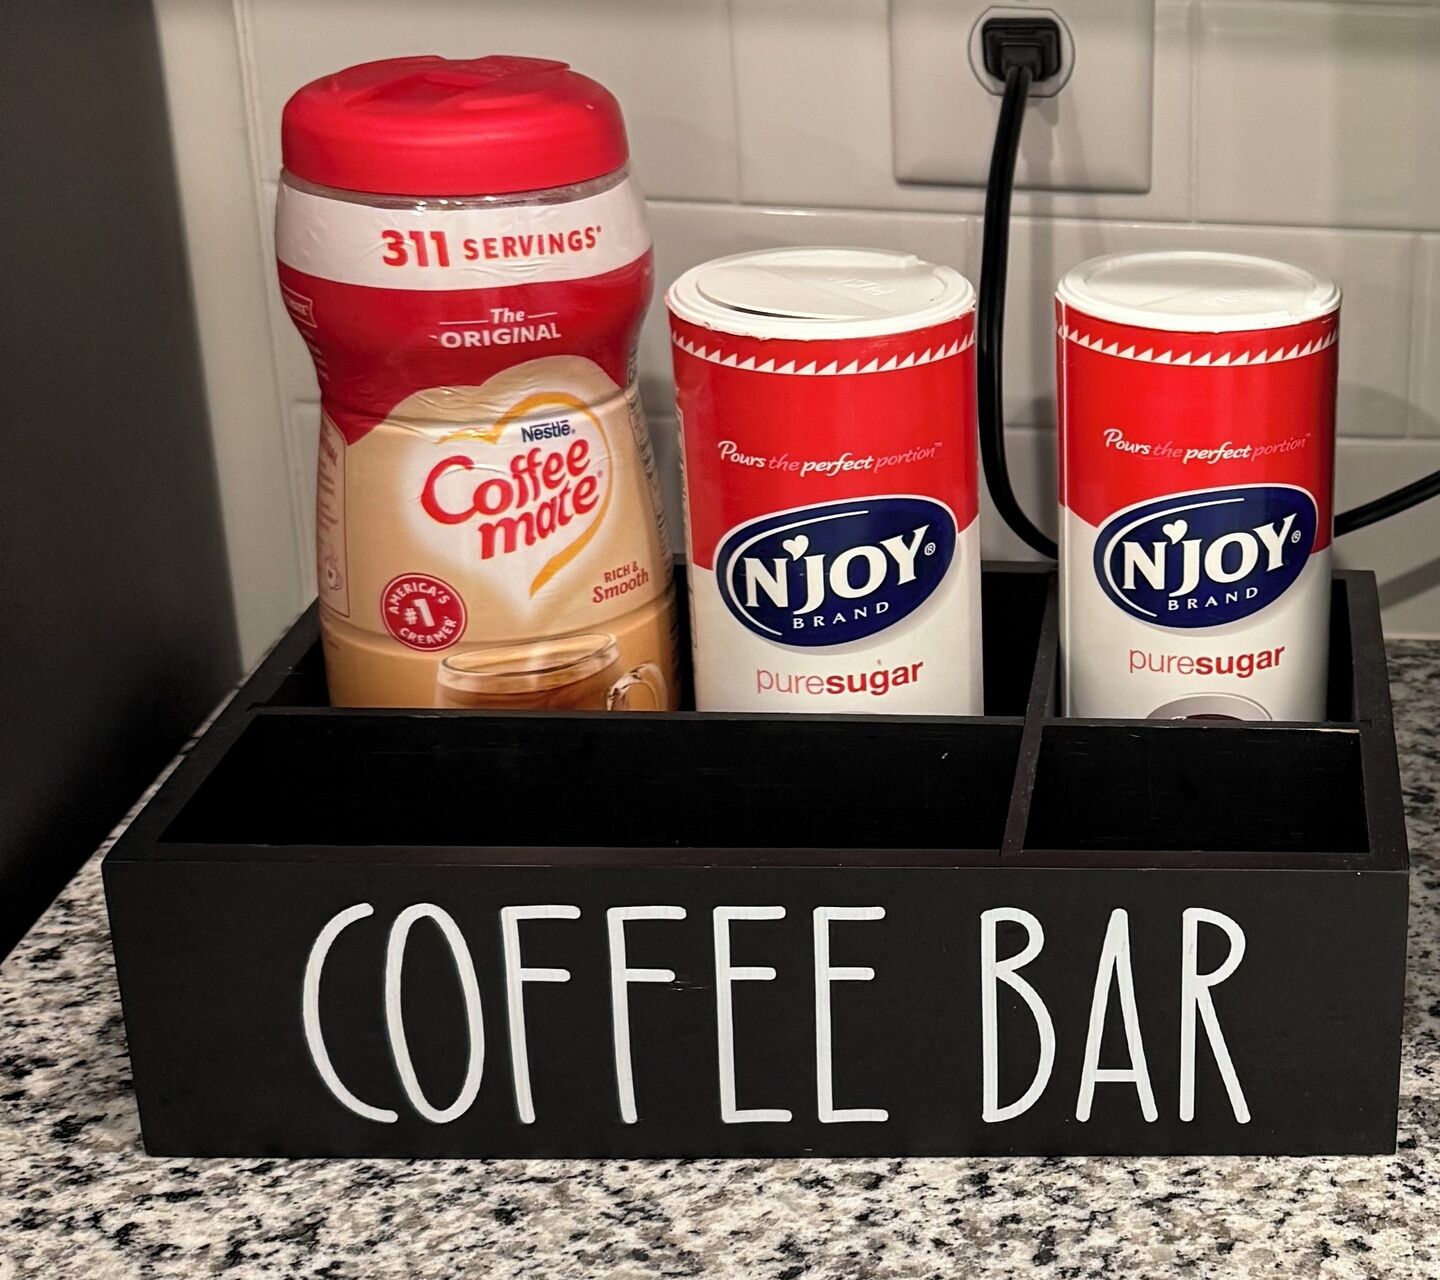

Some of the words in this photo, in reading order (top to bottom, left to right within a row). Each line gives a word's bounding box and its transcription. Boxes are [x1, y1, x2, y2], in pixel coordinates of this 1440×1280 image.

[382, 229, 451, 267] 311
[490, 308, 525, 324] The
[440, 322, 562, 349] ORIGINAL
[718, 440, 766, 468] Pours
[768, 453, 800, 471] the
[800, 452, 875, 477] perfect
[1103, 428, 1151, 455] Pours
[1152, 441, 1184, 459] the
[1183, 441, 1252, 464] perfect
[421, 439, 590, 525] Coffee
[478, 475, 600, 560] mate
[592, 568, 649, 603] Smooth
[604, 564, 631, 583] RICH
[632, 560, 639, 572] &
[389, 582, 451, 615] AMERICA'S
[404, 598, 436, 627] #1
[793, 601, 890, 629] BRAND
[1168, 587, 1259, 611] BRAND
[400, 618, 457, 644] CREAMER
[302, 903, 889, 1123] COFFEE
[980, 906, 1252, 1123] BAR
